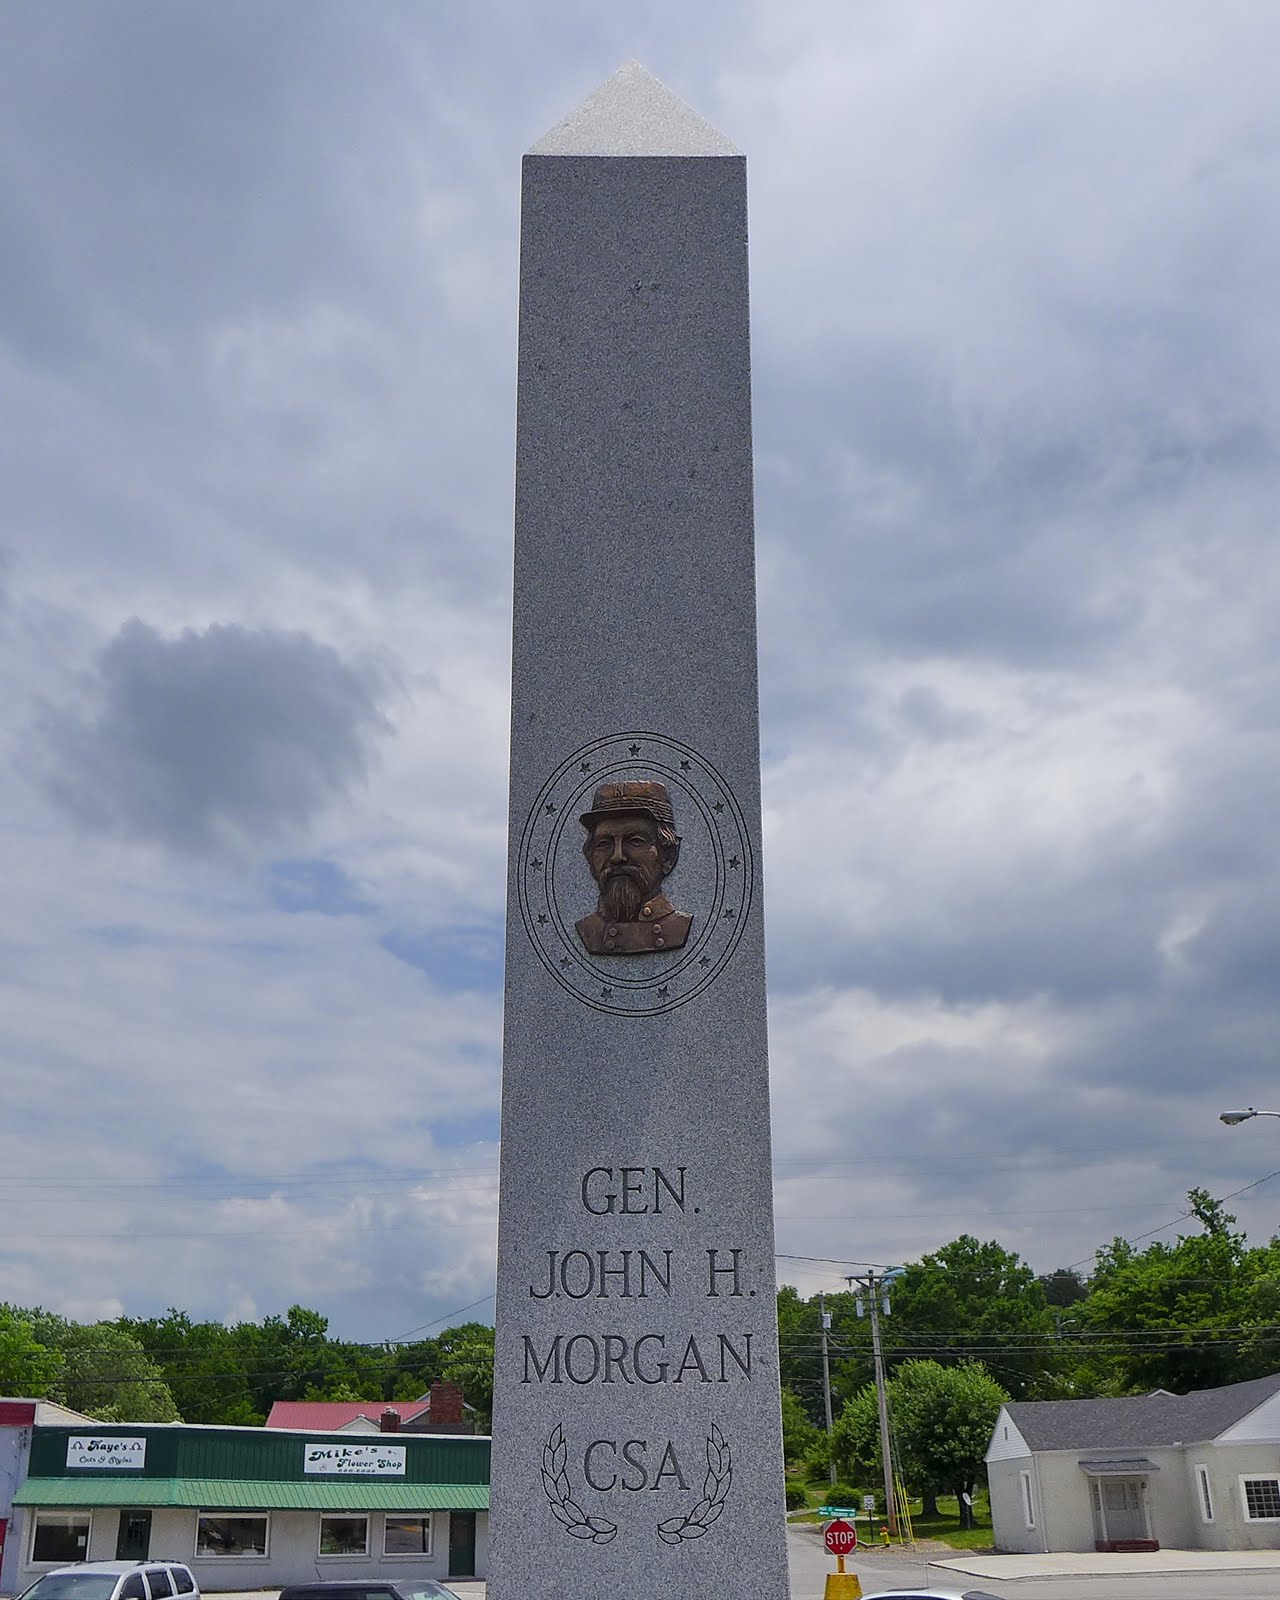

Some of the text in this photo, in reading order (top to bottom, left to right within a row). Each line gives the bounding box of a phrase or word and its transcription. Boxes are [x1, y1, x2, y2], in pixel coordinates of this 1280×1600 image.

[581, 1166, 701, 1216] GEN.
[529, 1248, 757, 1299] JOHN H.
[520, 1333, 754, 1385] MORGAN
[87, 1439, 128, 1453] Kaye's
[308, 1446, 378, 1462] Mike's
[336, 1458, 403, 1469] Flower Shop
[583, 1439, 691, 1493] CSA
[826, 1531, 854, 1545] STOP
